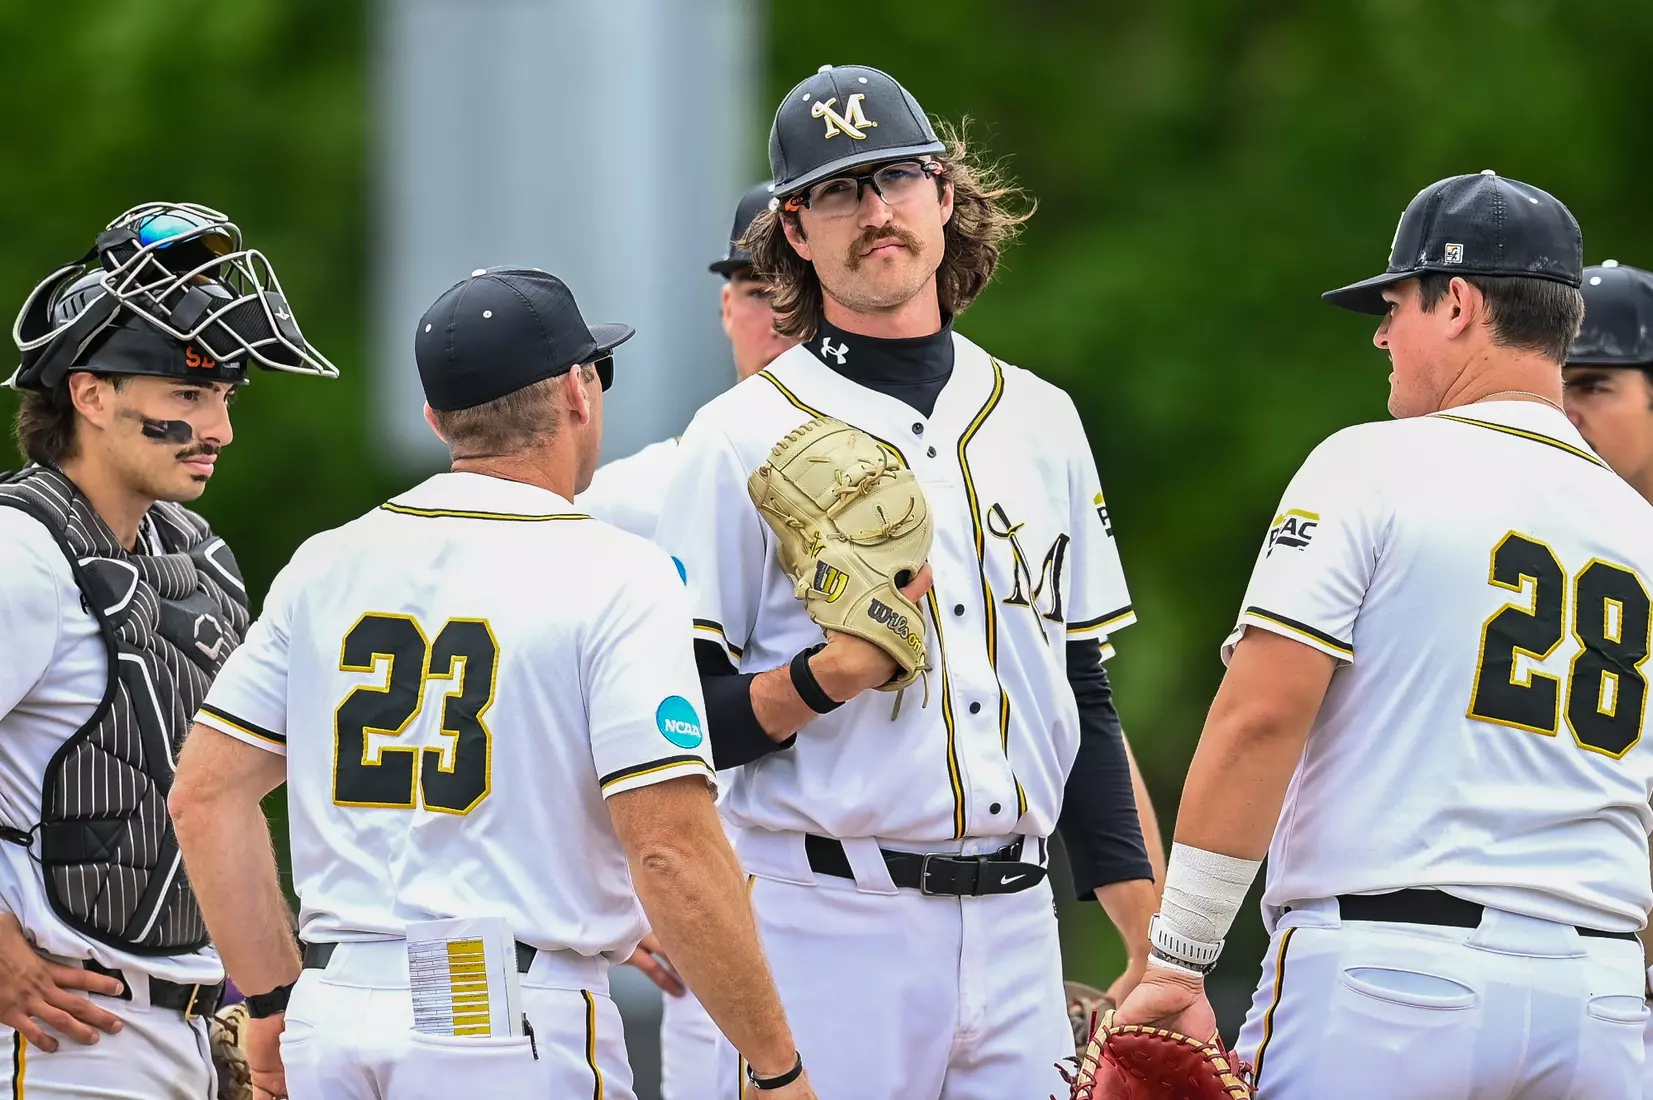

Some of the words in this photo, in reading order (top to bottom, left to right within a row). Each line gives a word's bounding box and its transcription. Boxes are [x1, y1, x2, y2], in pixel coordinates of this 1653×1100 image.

[1268, 517, 1318, 549] PAC
[867, 598, 922, 656] Wilson
[1465, 529, 1653, 761] 28
[332, 611, 501, 817] 23
[664, 718, 702, 738] NCAA
